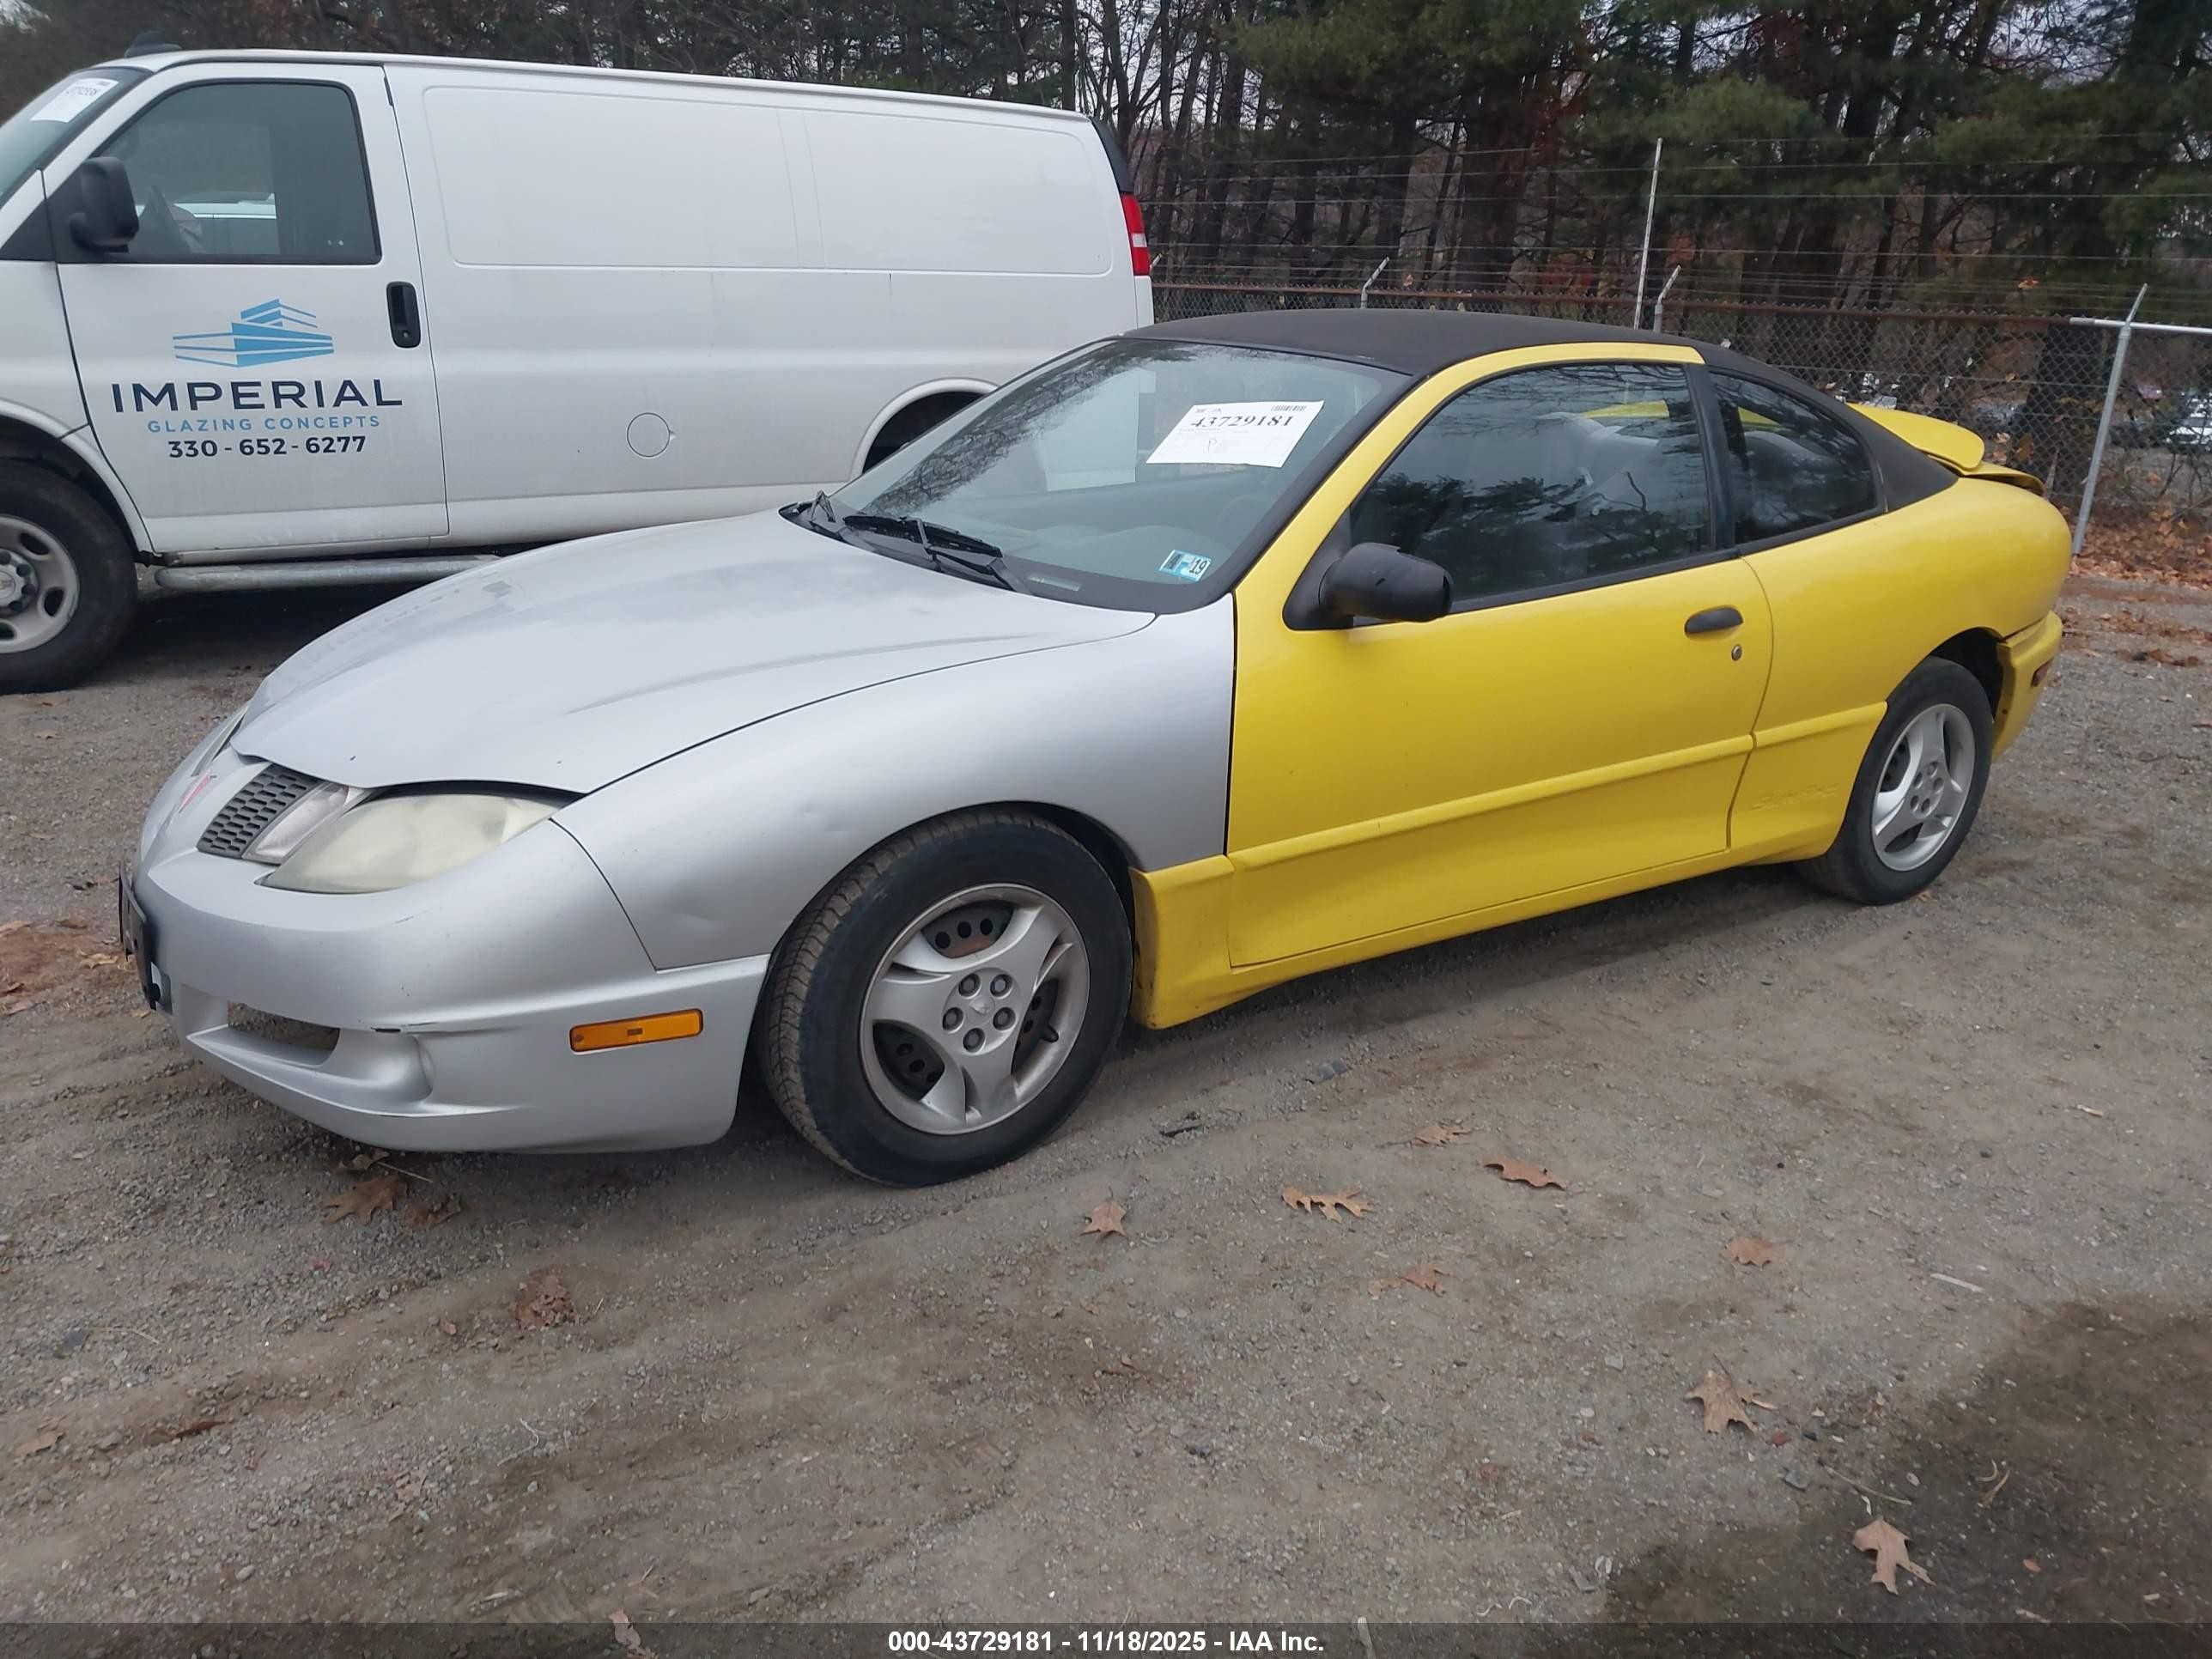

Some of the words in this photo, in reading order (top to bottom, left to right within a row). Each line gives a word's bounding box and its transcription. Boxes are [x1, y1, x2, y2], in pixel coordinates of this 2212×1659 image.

[112, 379, 403, 413] IMPERIAL
[148, 418, 252, 434] GLAZING
[264, 415, 380, 430] CONCEPTS
[1190, 415, 1295, 428] 43729181
